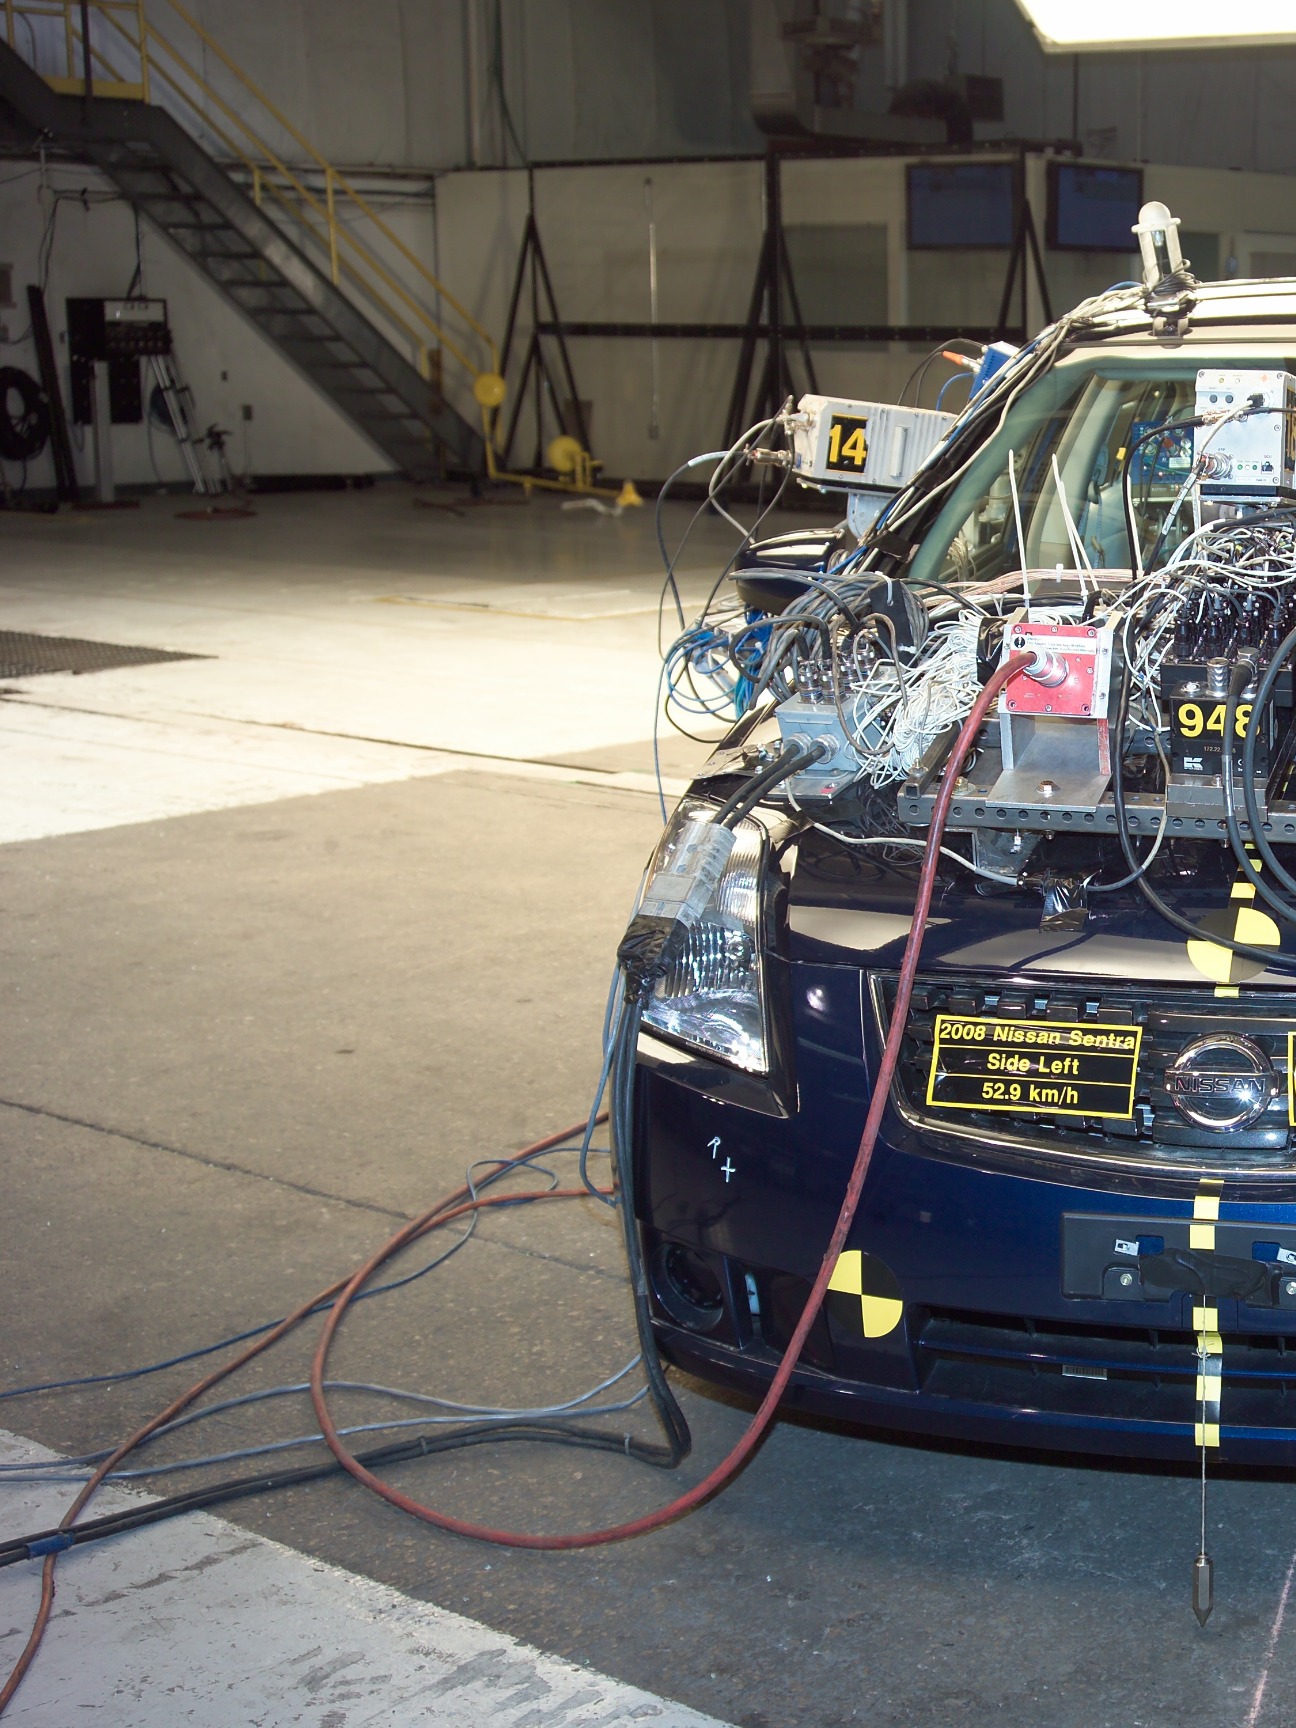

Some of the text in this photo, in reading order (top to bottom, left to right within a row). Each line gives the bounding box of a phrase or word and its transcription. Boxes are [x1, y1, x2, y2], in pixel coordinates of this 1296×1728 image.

[829, 424, 867, 465] 14
[1178, 703, 1260, 738] 948
[940, 1023, 1135, 1049] 2008 Nissan Sentra
[986, 1053, 1080, 1074] Side Left
[981, 1082, 1078, 1105] 52.9 km/h
[1175, 1075, 1266, 1093] NISSAN
